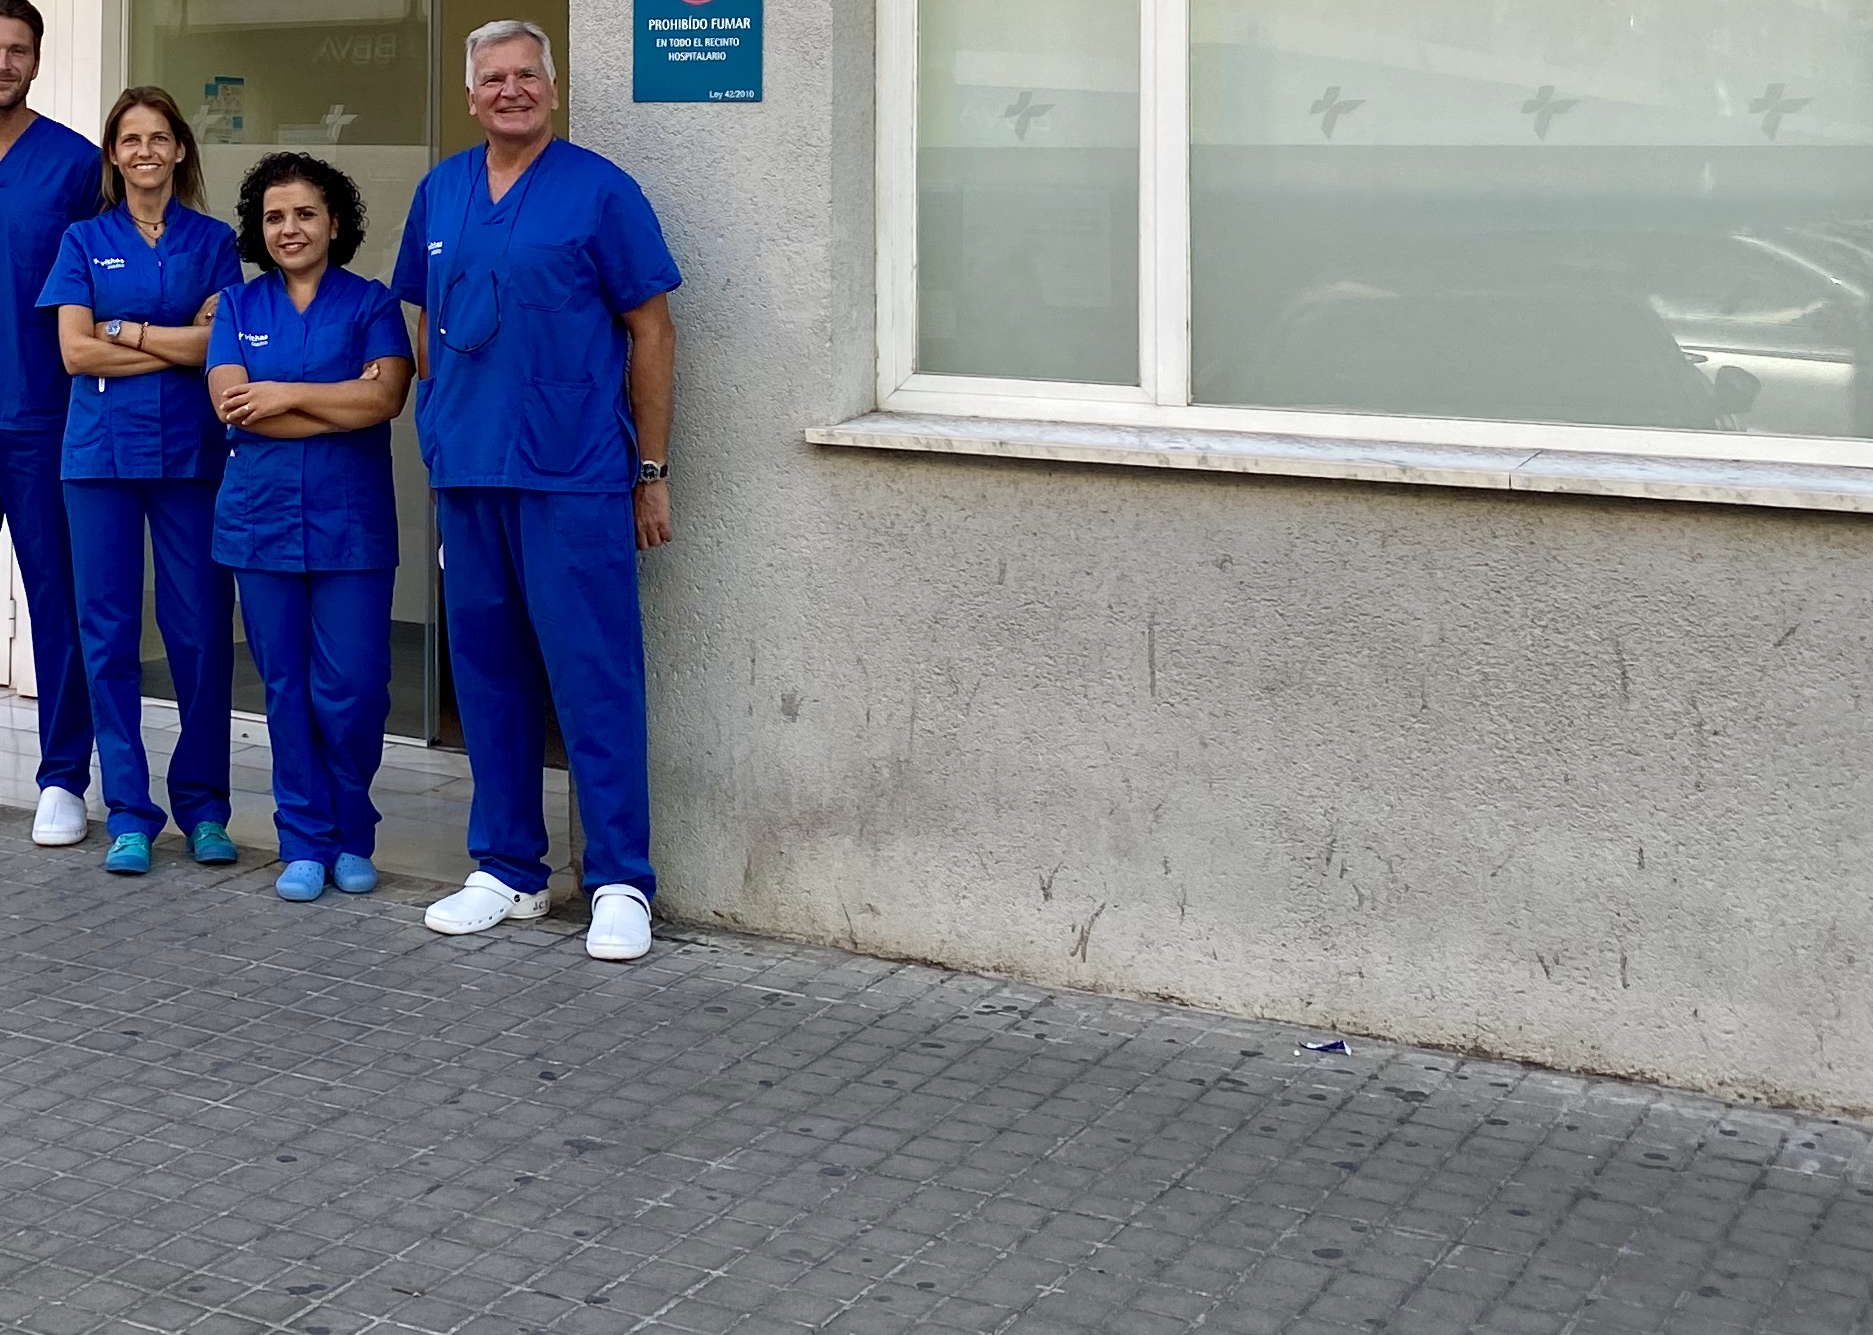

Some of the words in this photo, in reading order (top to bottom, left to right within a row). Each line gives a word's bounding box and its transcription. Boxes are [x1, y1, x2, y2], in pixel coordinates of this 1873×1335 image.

[711, 17, 751, 30] FUMAR
[656, 38, 668, 48] EN
[669, 38, 691, 47] TODO
[693, 37, 704, 47] EL
[705, 37, 740, 47] RECINTO
[668, 51, 727, 61] HOSPITALARIO
